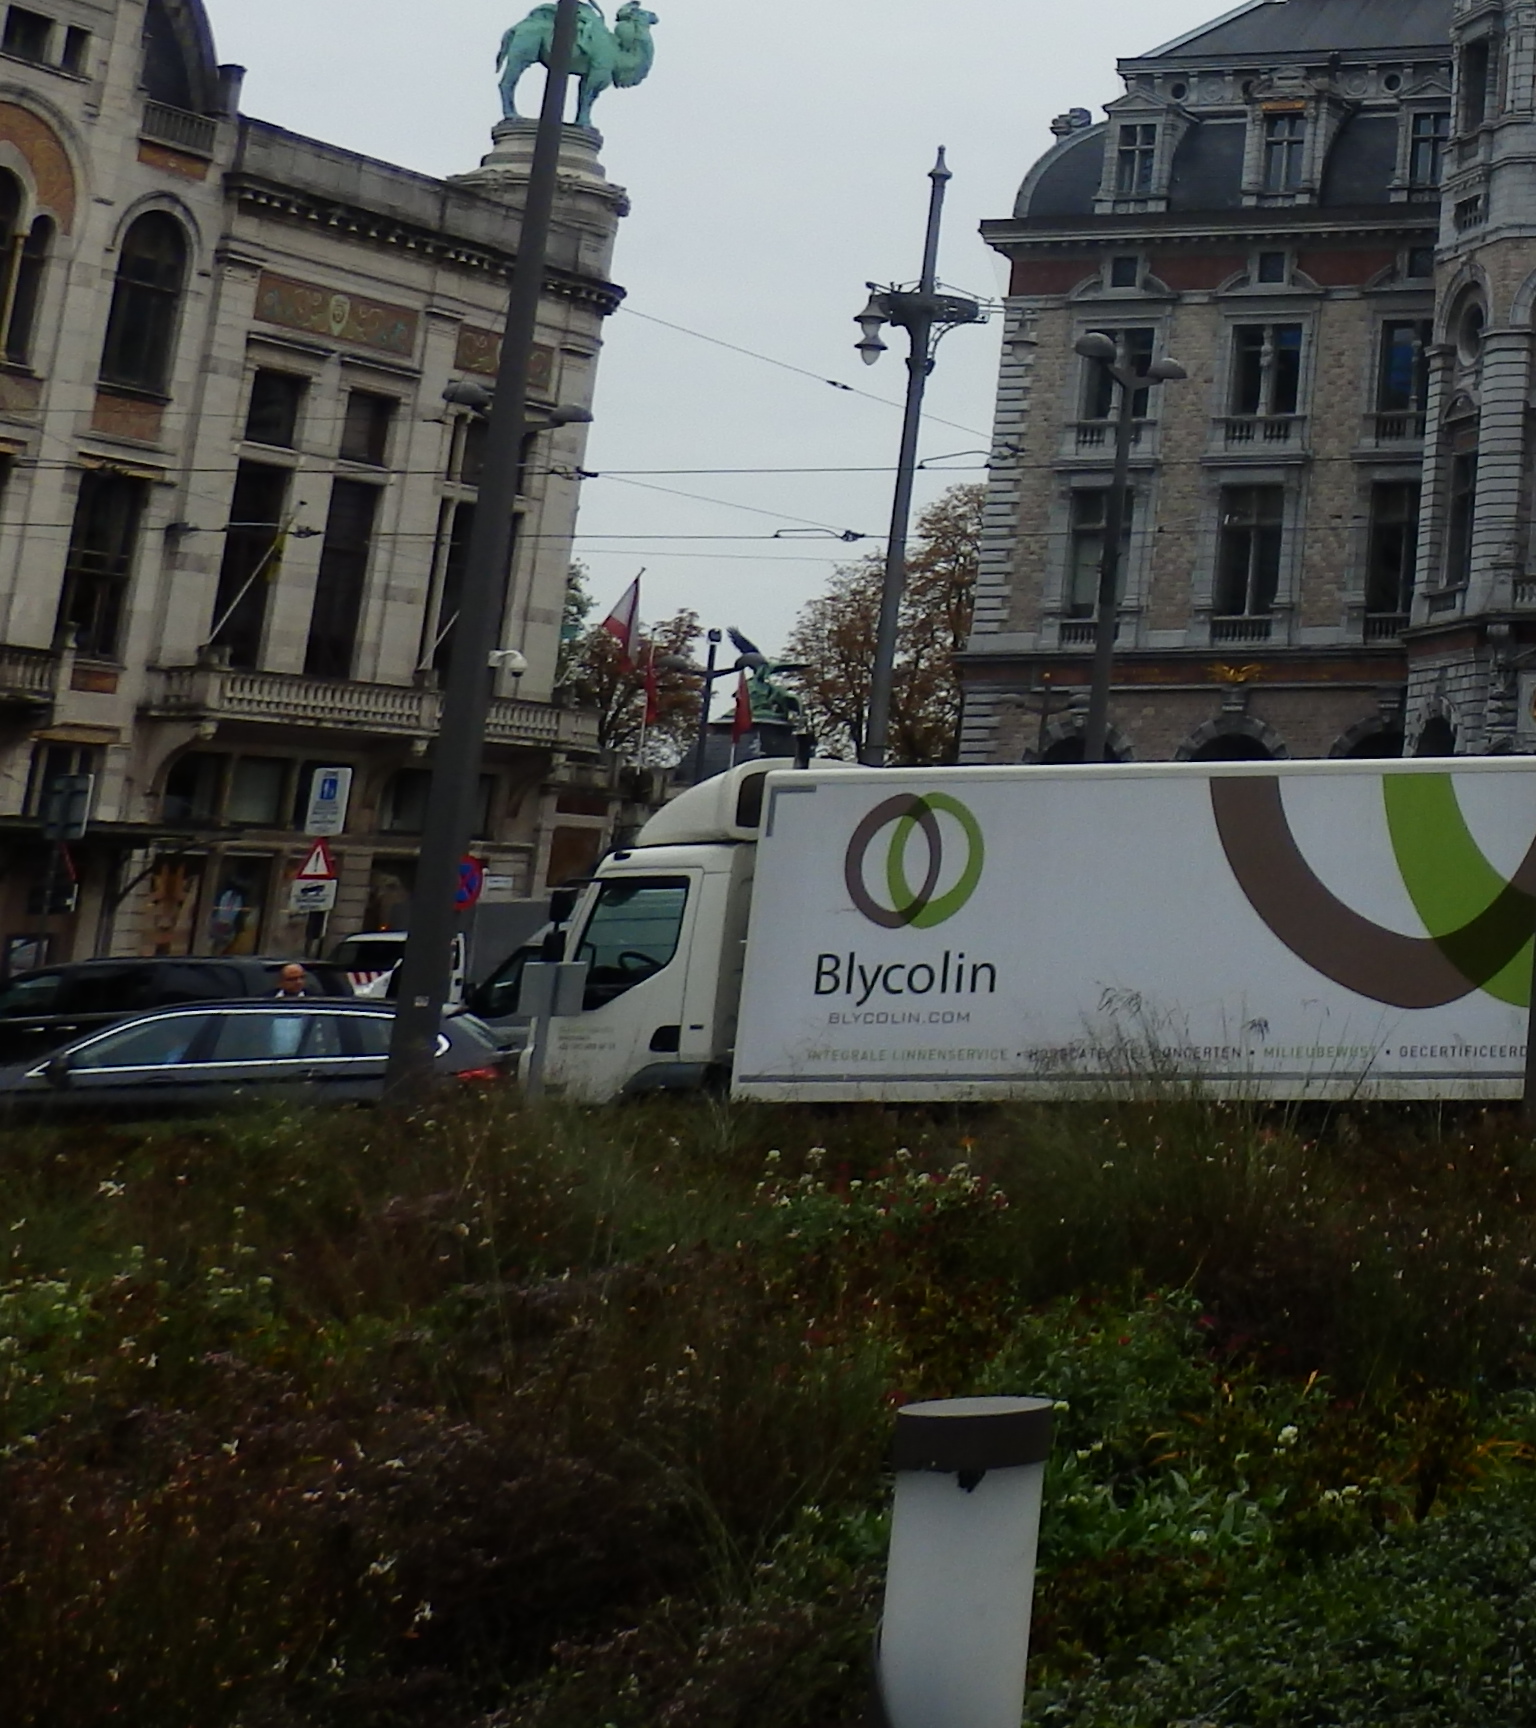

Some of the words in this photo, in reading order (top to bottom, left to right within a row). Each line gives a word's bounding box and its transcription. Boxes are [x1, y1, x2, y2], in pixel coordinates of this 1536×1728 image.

[814, 950, 997, 1007] Blycolin
[828, 1012, 971, 1025] BLYCOLIN.COM
[808, 1048, 888, 1062] INTEGRALE
[892, 1047, 1009, 1062] LINNENSERVICE
